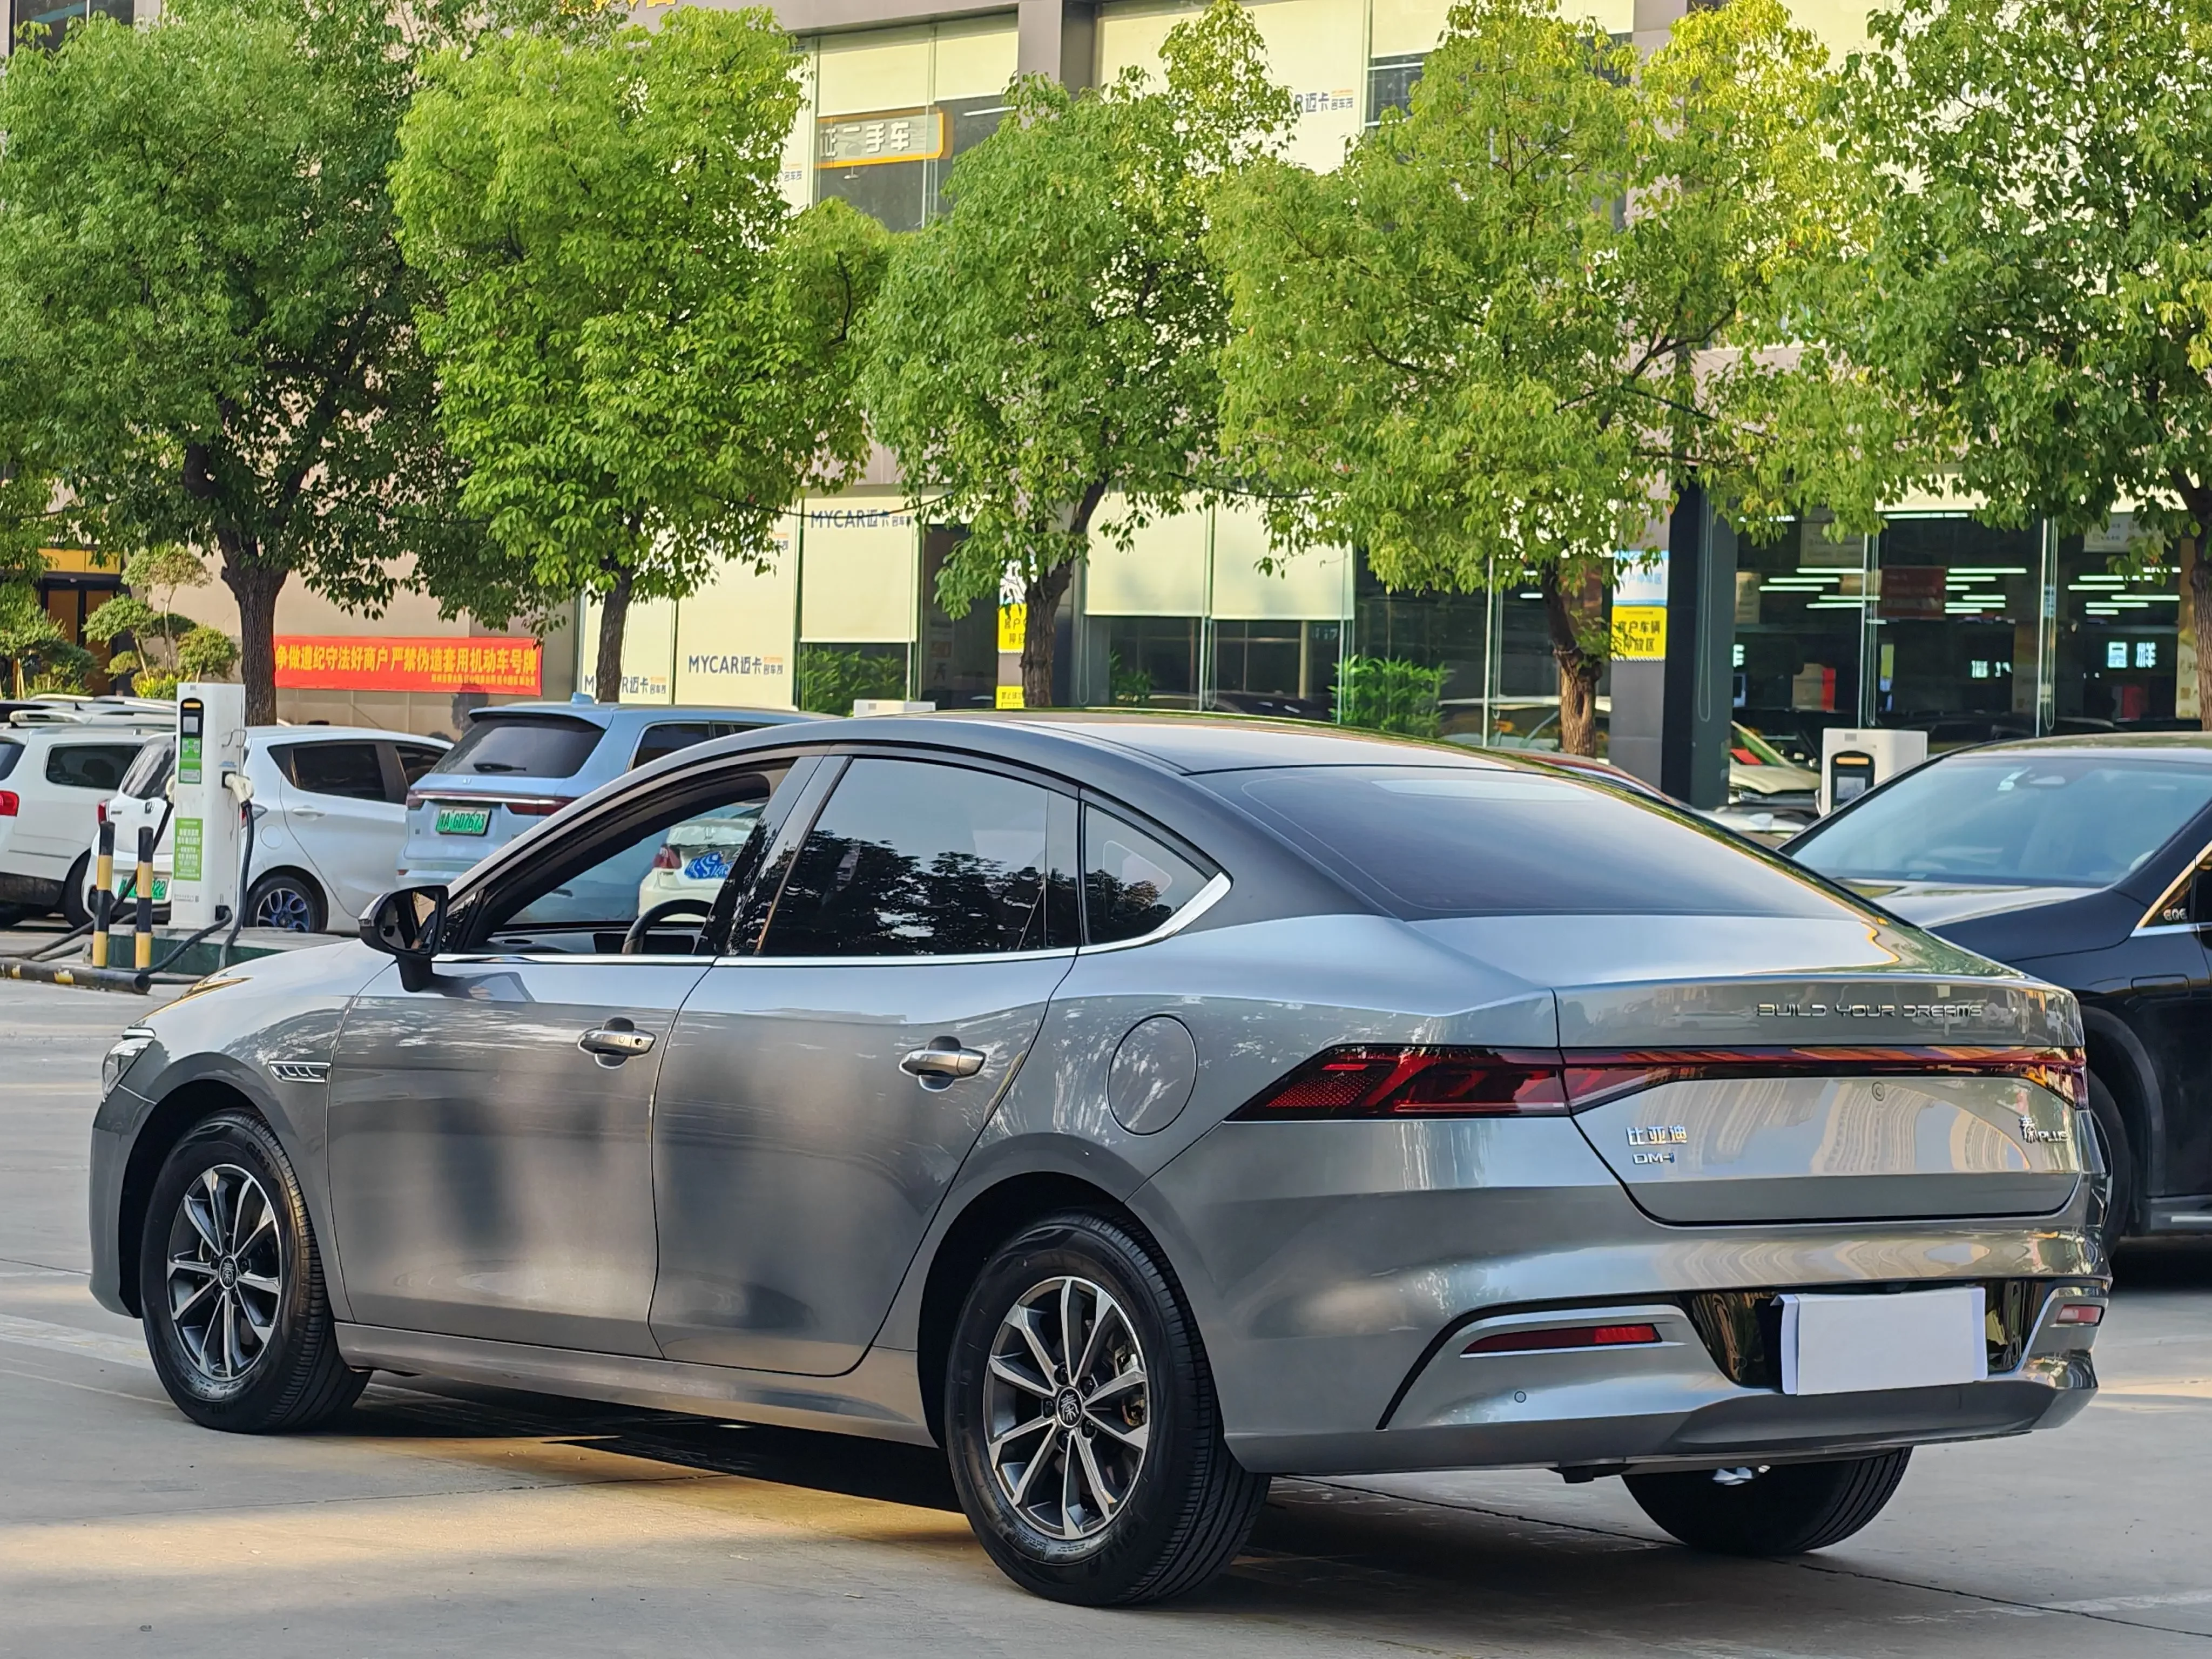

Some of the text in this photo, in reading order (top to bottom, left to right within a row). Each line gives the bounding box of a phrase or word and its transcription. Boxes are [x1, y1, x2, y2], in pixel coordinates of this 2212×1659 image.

[1757, 1003, 1984, 1018] BUILD YOUR DREAMS
[1626, 1124, 1688, 1146] 比亚迪
